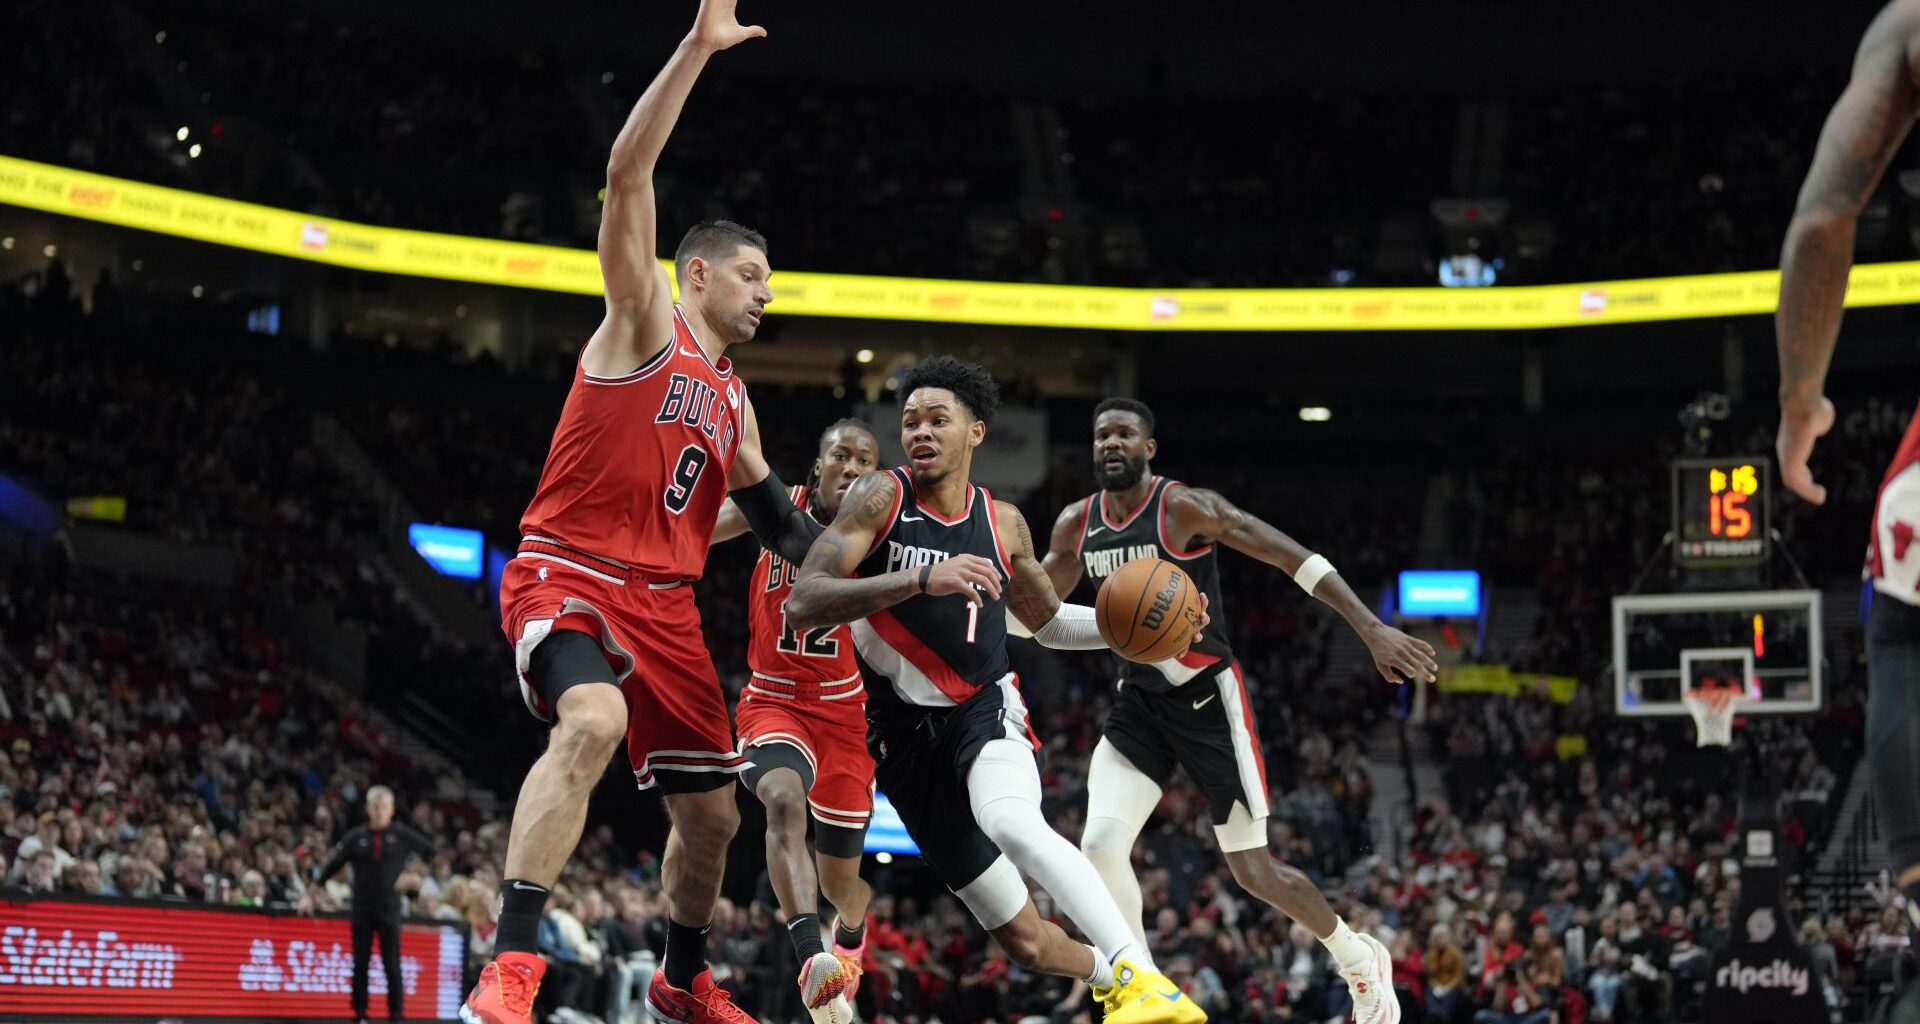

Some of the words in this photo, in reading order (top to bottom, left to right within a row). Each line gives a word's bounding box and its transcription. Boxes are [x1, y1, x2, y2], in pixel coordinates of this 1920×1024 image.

[663, 443, 708, 515] 9
[1709, 491, 1751, 538] 15
[967, 601, 978, 643] 1
[1141, 570, 1181, 631] Wilson
[776, 599, 839, 658] 12
[1716, 958, 1808, 995] ripcity
